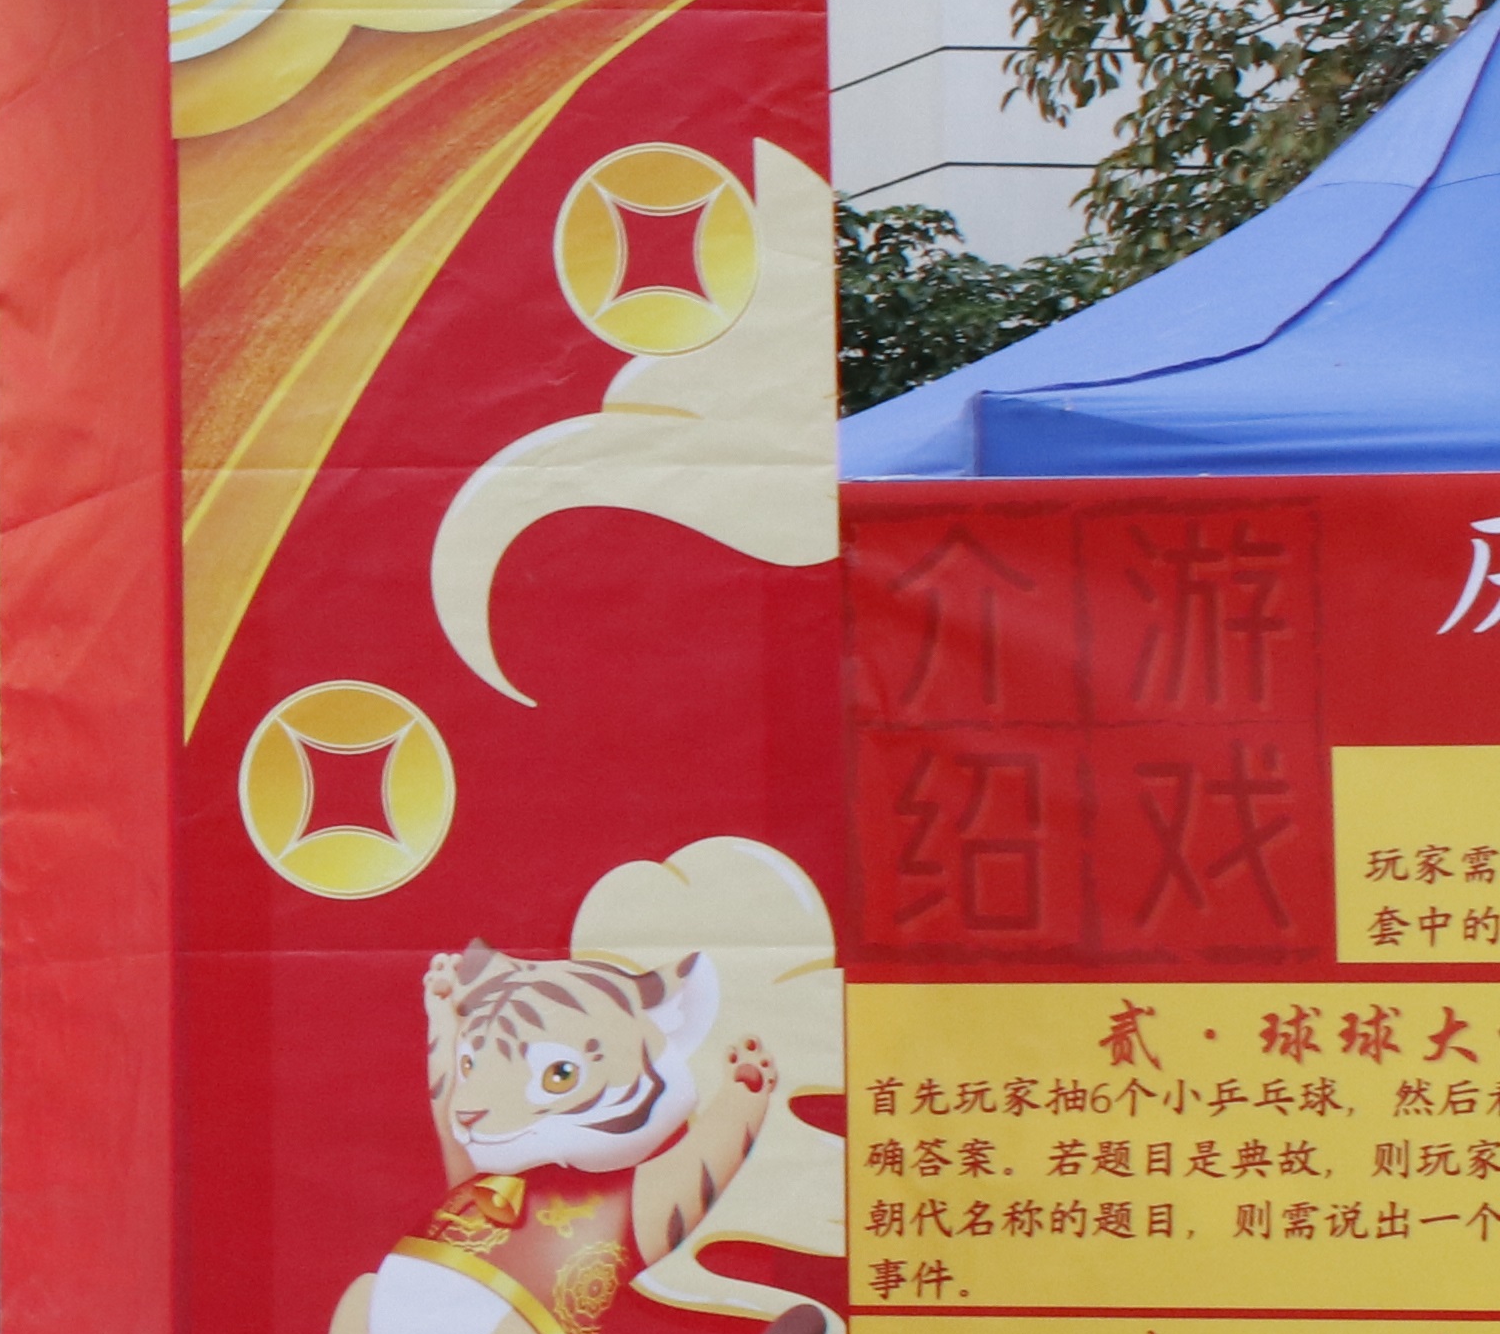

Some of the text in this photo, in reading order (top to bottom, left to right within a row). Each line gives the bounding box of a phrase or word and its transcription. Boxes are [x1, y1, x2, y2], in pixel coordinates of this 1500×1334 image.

[1364, 844, 1500, 885] 玩家需
[1366, 905, 1500, 947] 套中的
[1098, 998, 1500, 1071] 贰·球球大
[867, 1258, 971, 1301] 事件。
